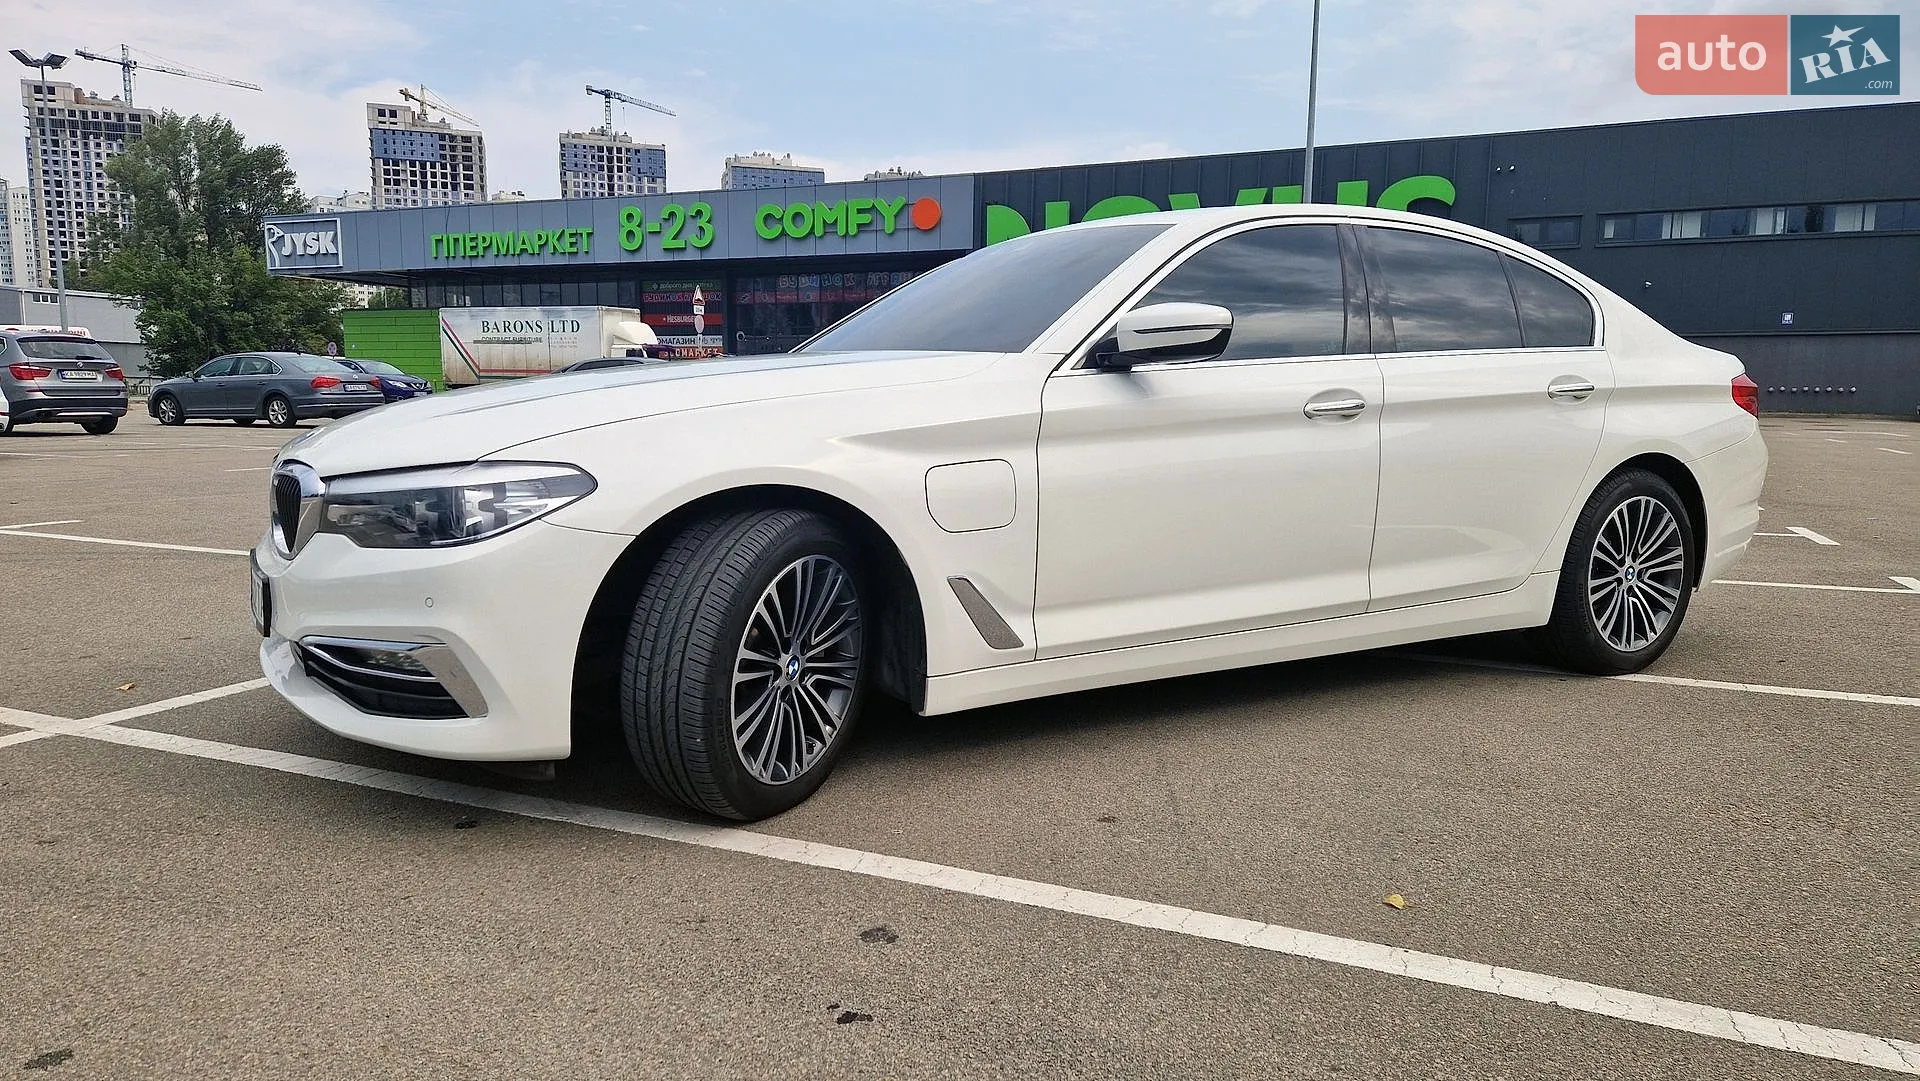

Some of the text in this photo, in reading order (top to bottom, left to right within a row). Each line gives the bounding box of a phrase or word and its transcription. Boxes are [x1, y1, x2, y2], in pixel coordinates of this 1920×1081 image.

[431, 201, 716, 259] ГІПЕРМАРКЕТ 8-23
[755, 195, 906, 240] COMFY
[281, 231, 338, 256] JYSK
[481, 320, 580, 333] BARONS LTD
